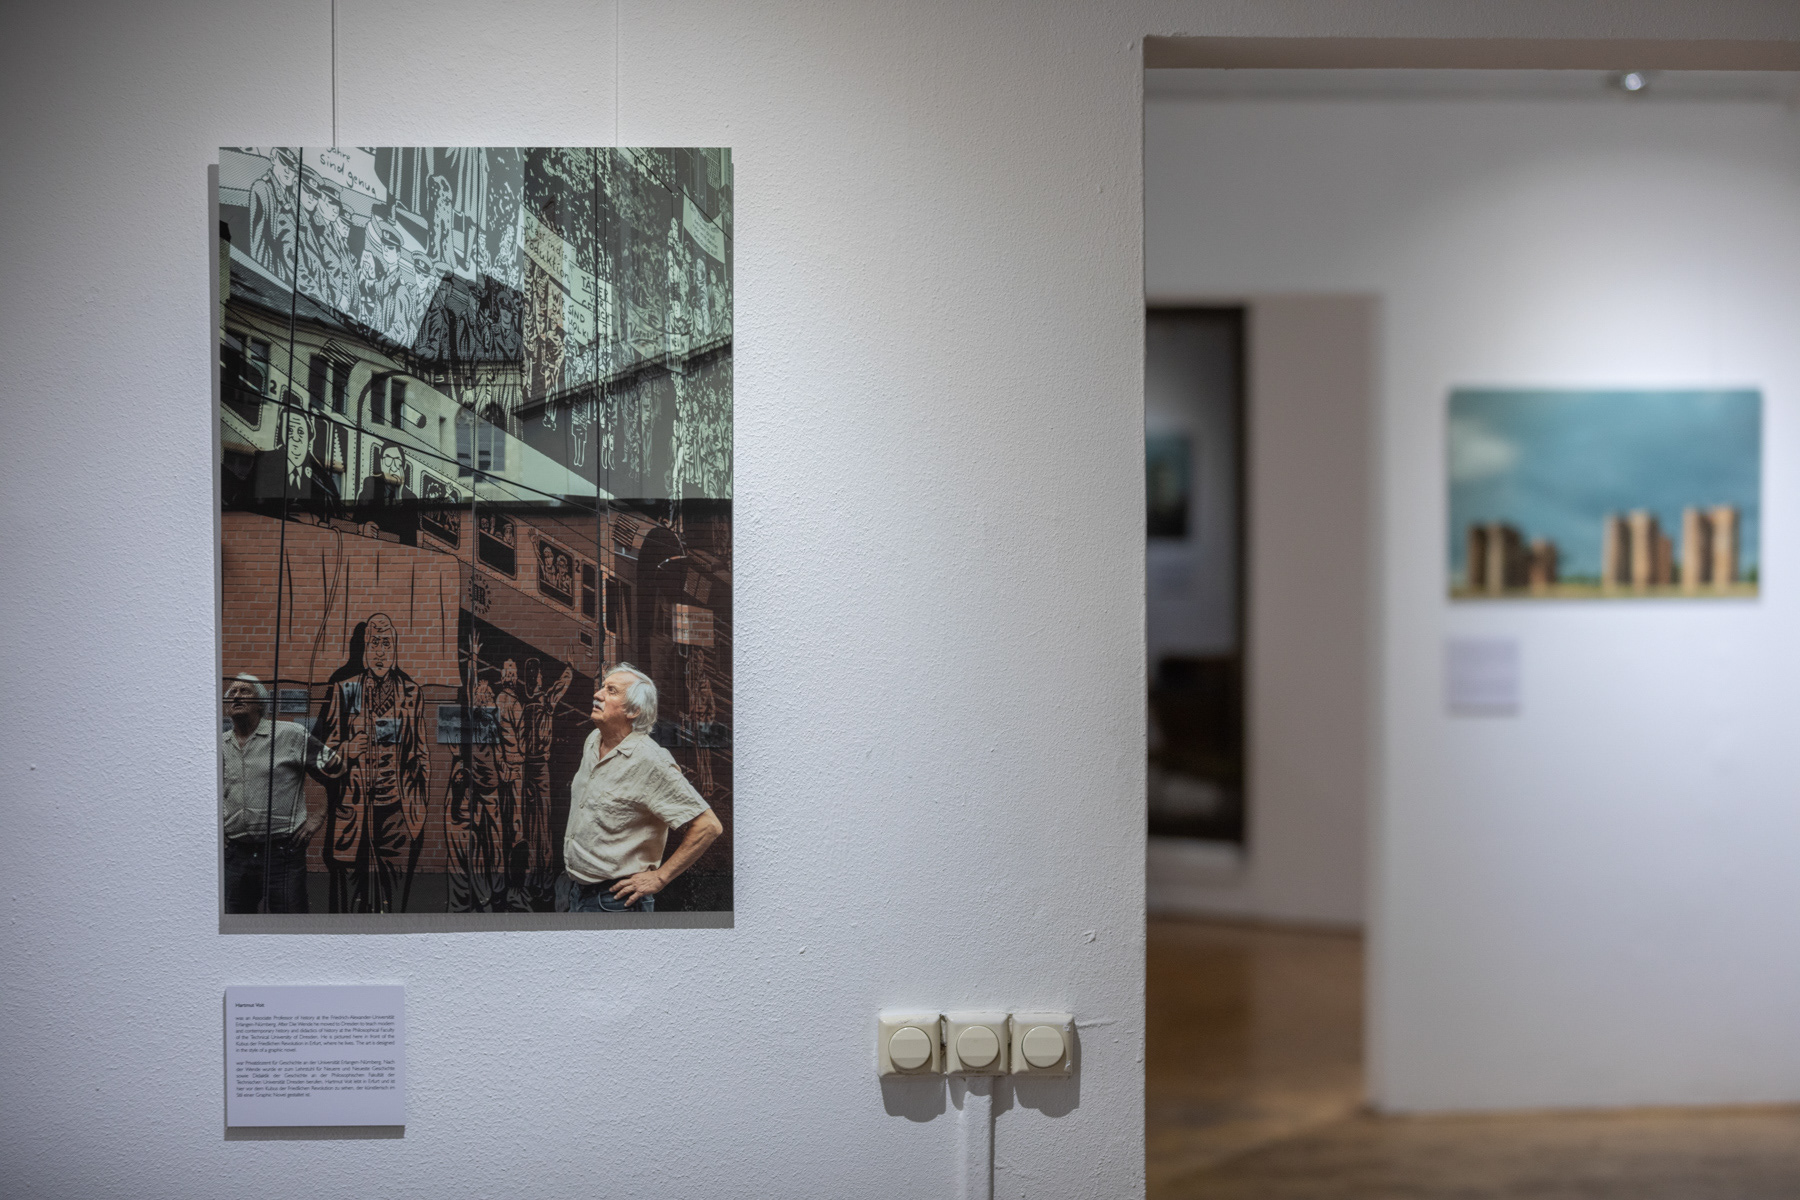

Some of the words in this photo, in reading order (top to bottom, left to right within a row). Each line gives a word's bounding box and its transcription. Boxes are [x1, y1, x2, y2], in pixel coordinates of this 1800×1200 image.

[320, 154, 345, 175] Sind
[567, 304, 586, 324] SIND
[270, 379, 277, 395] 2
